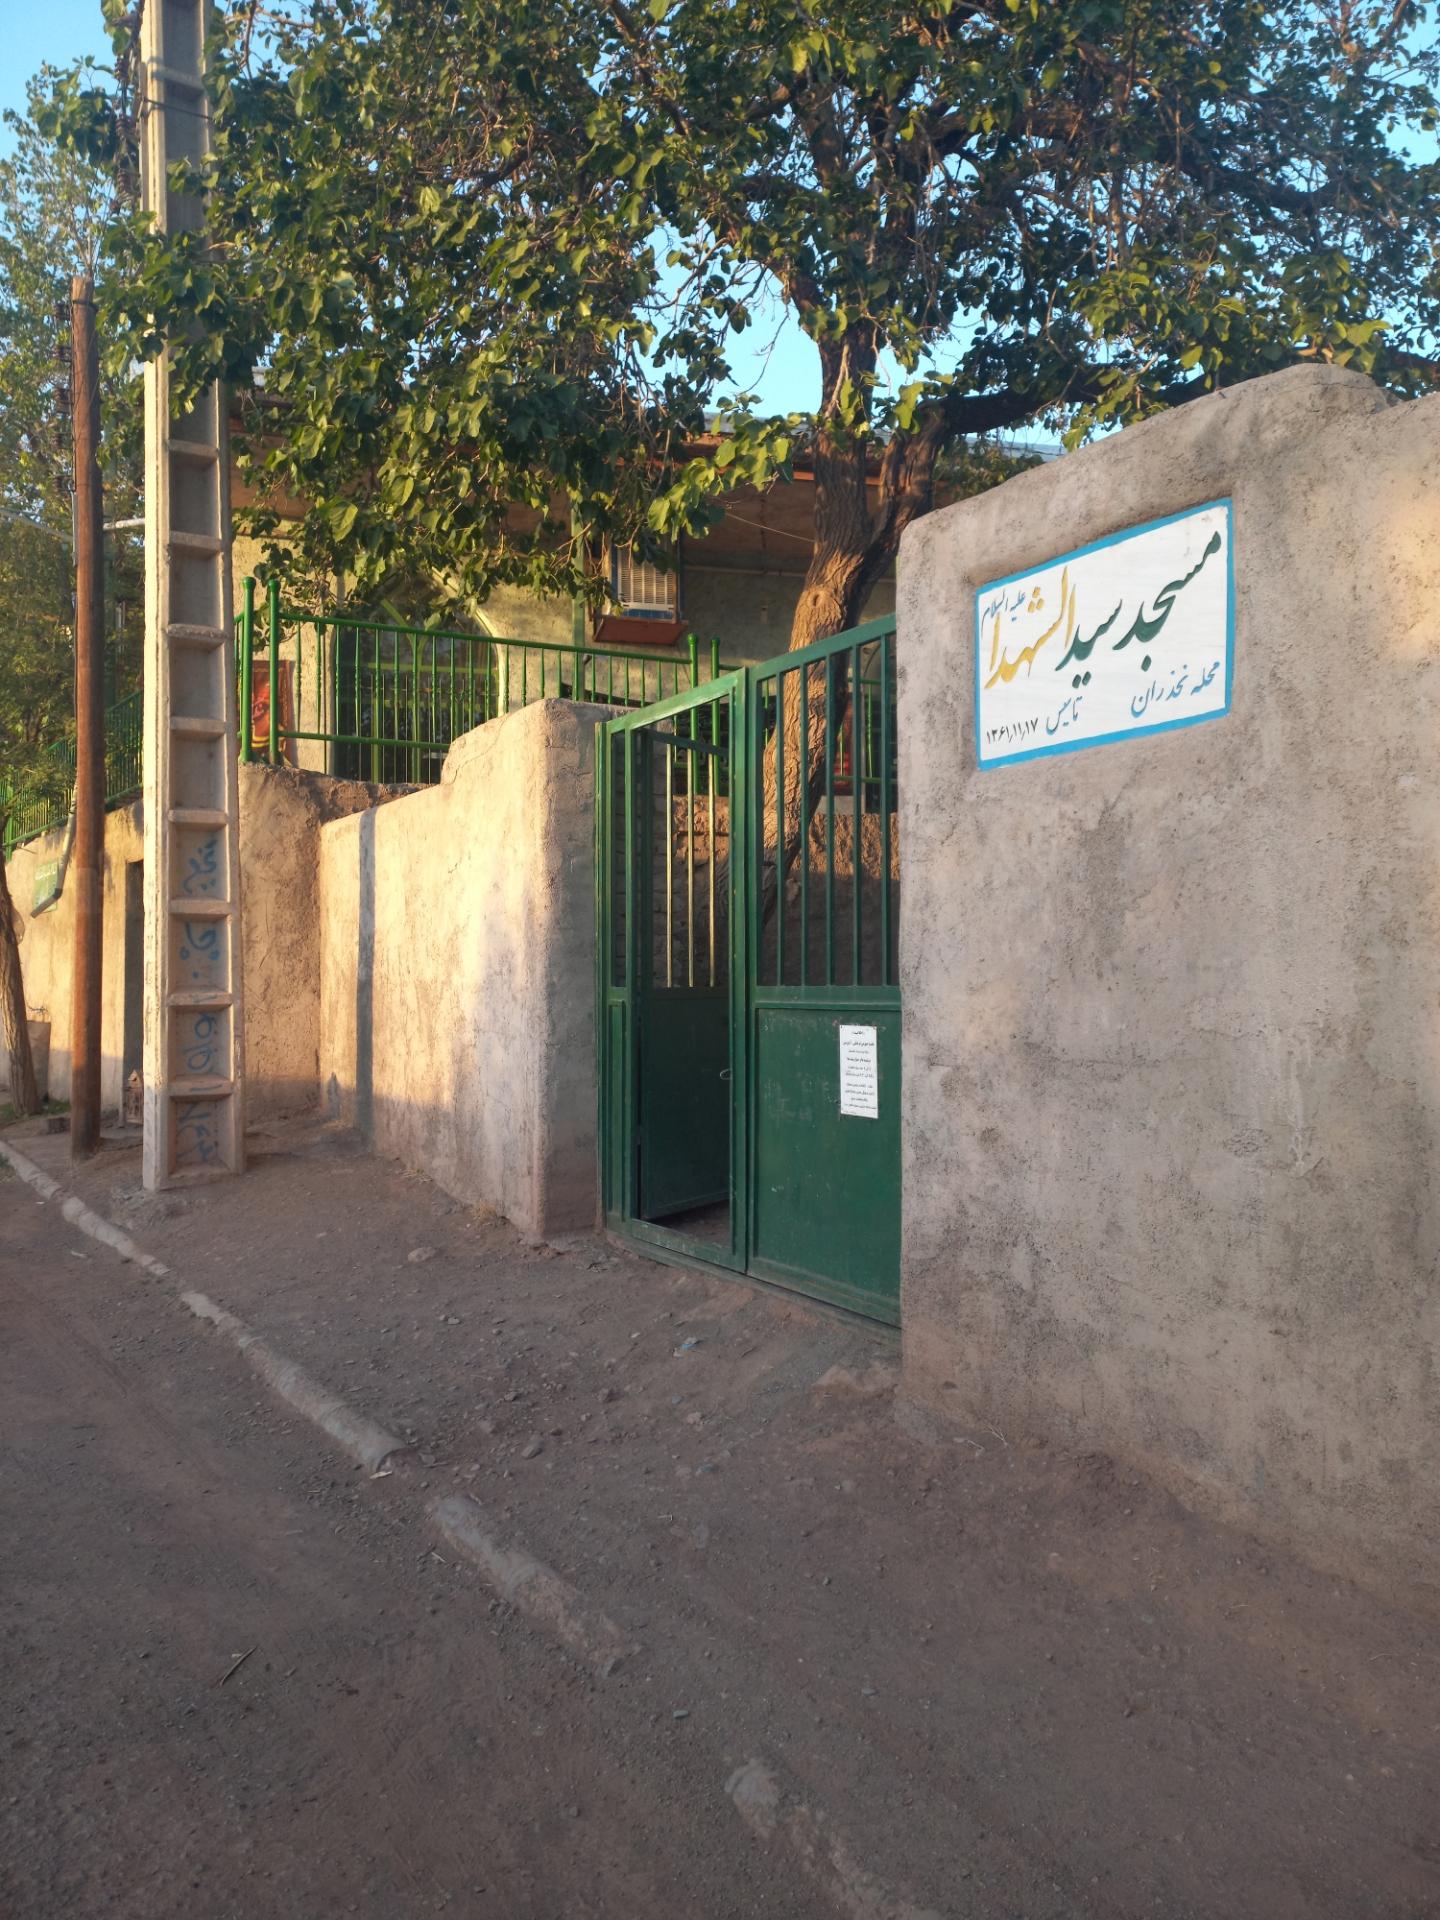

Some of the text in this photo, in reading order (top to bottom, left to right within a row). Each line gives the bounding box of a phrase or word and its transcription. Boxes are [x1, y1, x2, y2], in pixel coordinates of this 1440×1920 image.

[1010, 590, 1026, 622] علیه
[1112, 531, 1222, 672] مسجد
[1055, 599, 1123, 689] سید
[1190, 661, 1220, 696] محله
